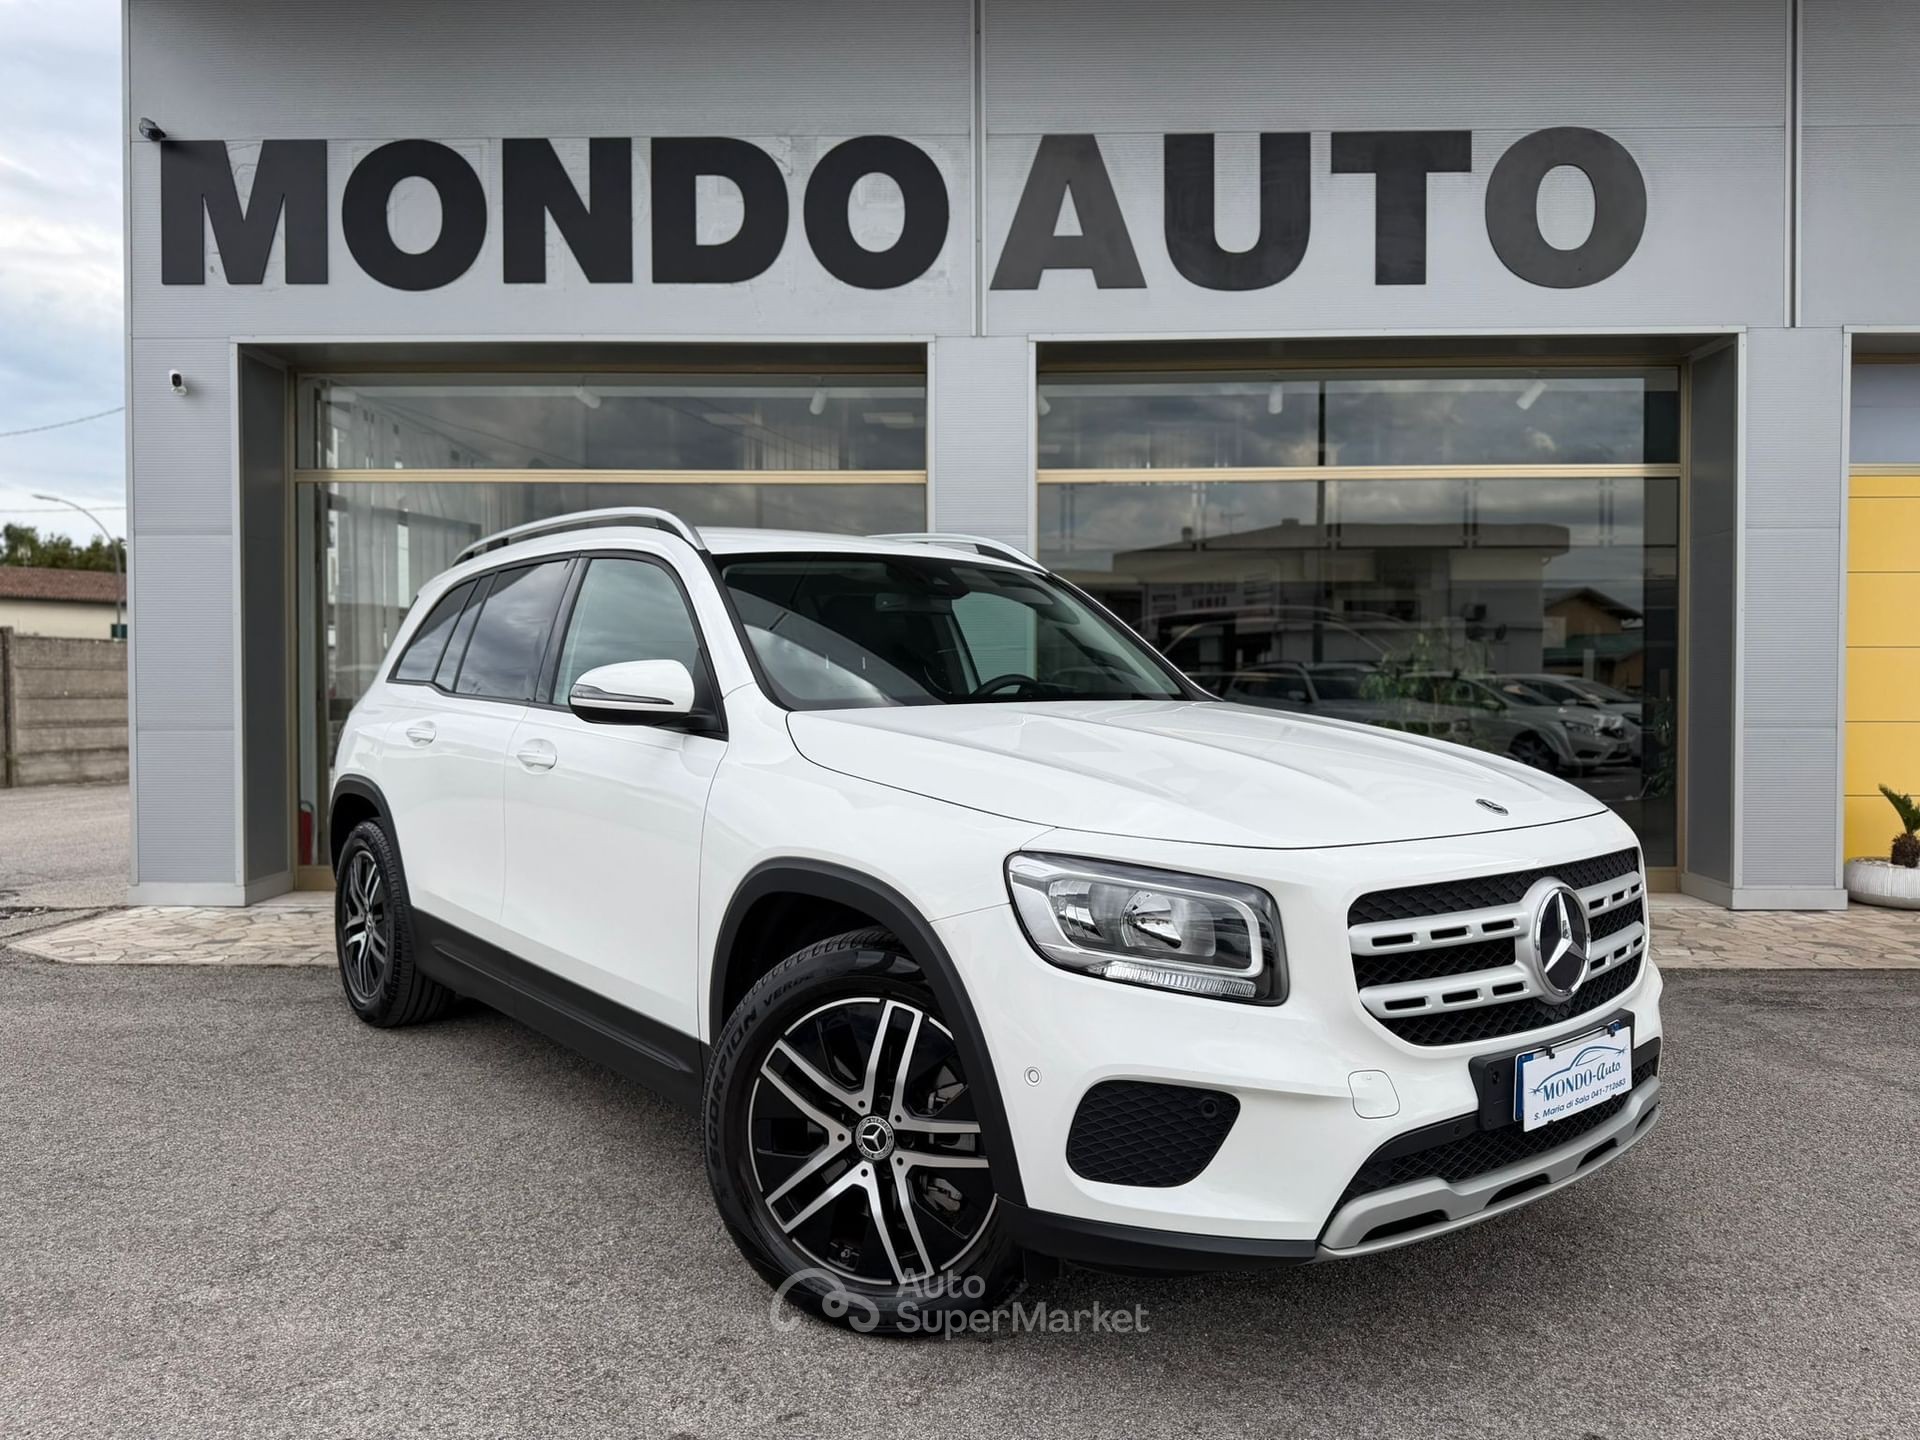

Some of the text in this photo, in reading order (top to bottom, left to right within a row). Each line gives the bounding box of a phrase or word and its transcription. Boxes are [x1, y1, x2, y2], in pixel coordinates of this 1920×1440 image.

[160, 126, 1647, 291] MONDO AUTO
[708, 1007, 757, 1170] SCORPION
[1543, 1104, 1564, 1117] Maria
[1566, 1101, 1573, 1109] di
[1575, 1094, 1590, 1105] Sala
